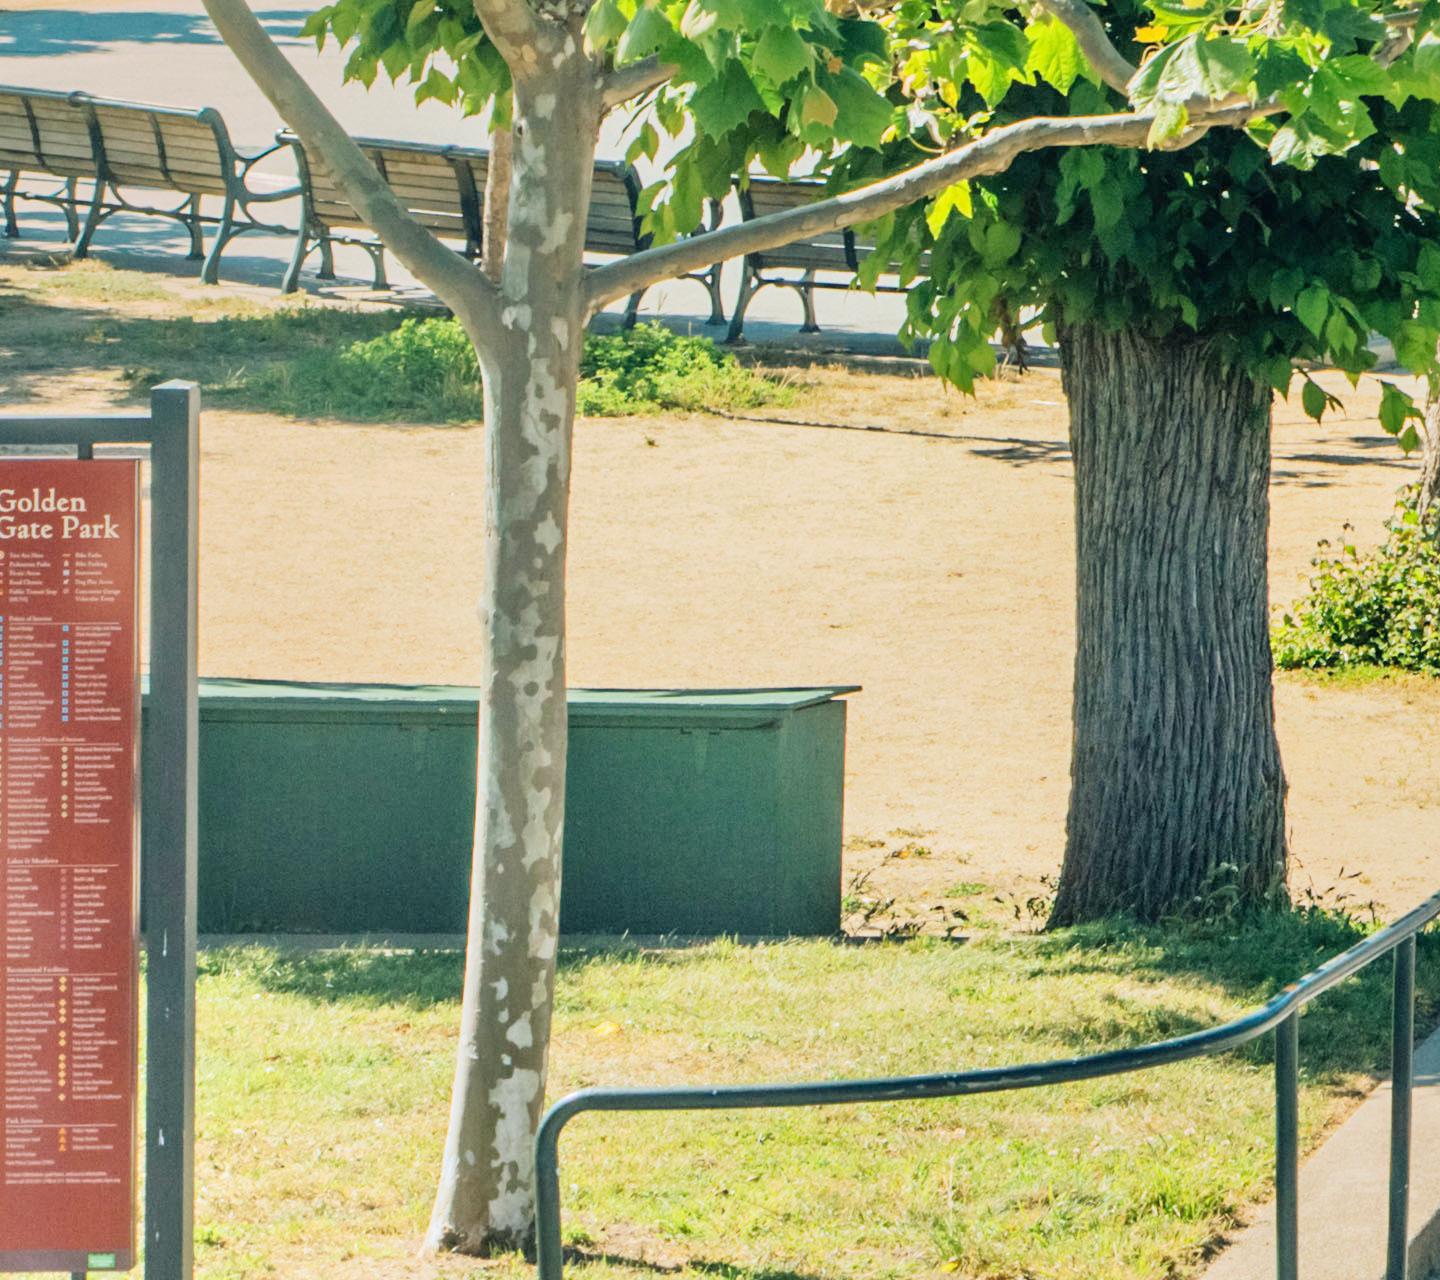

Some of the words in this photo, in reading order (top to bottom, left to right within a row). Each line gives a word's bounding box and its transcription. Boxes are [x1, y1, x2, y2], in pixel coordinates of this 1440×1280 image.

[0, 488, 88, 513] Golden
[0, 515, 54, 540] Gate
[61, 514, 120, 540] Park
